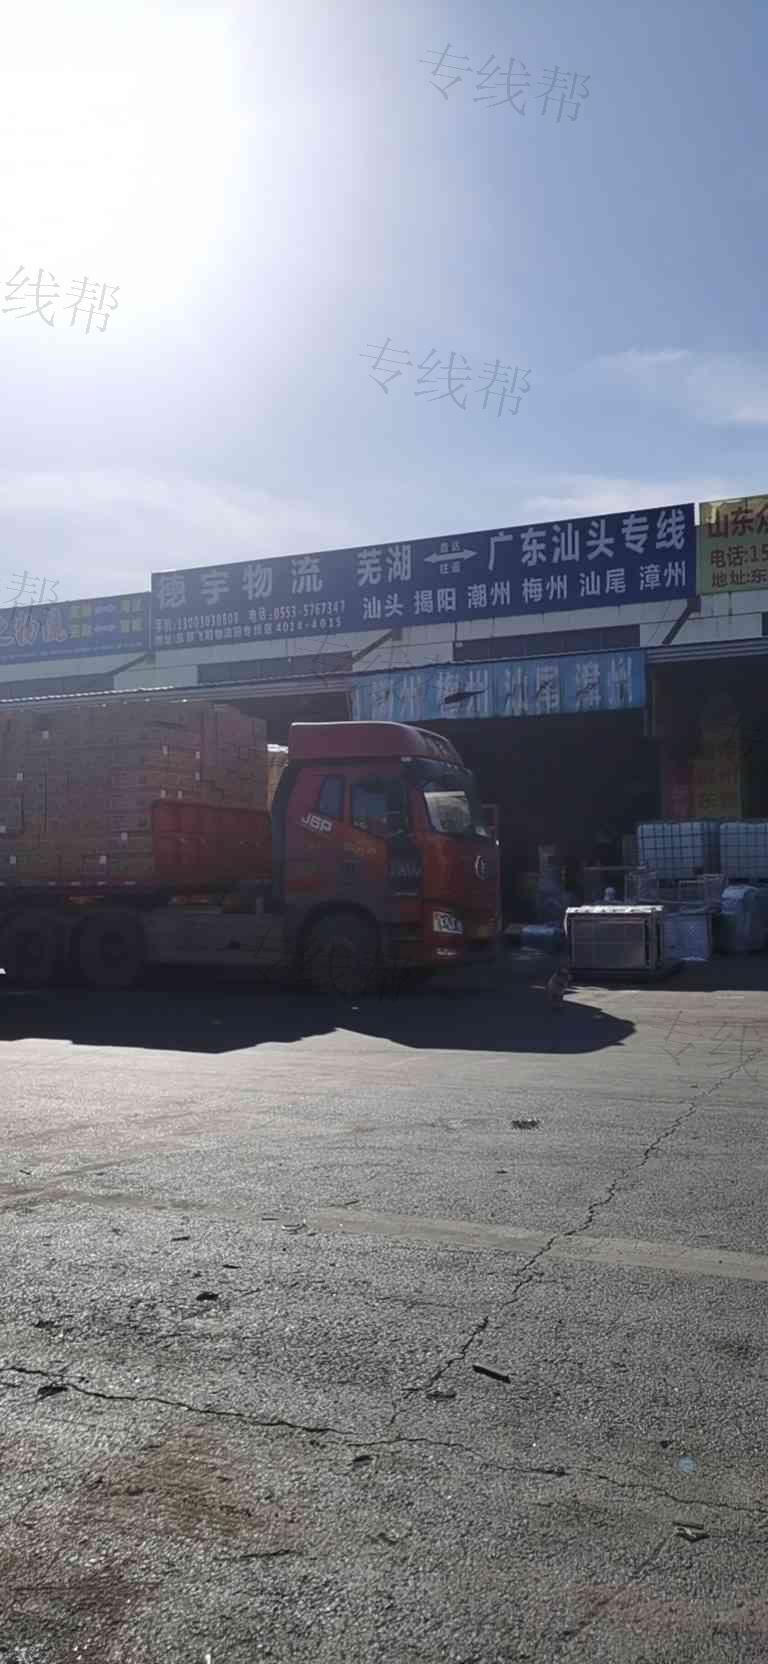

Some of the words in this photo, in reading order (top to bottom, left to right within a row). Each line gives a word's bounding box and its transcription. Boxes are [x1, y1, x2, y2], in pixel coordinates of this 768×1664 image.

[357, 544, 411, 586] 芜湖
[488, 508, 688, 572] 广东汕头专线
[362, 594, 404, 620] 汕头
[413, 587, 457, 614] 揭阳
[467, 580, 511, 609] 潮州
[521, 573, 568, 603] 梅州
[579, 568, 626, 598] 汕尾
[639, 561, 687, 592] 漳州
